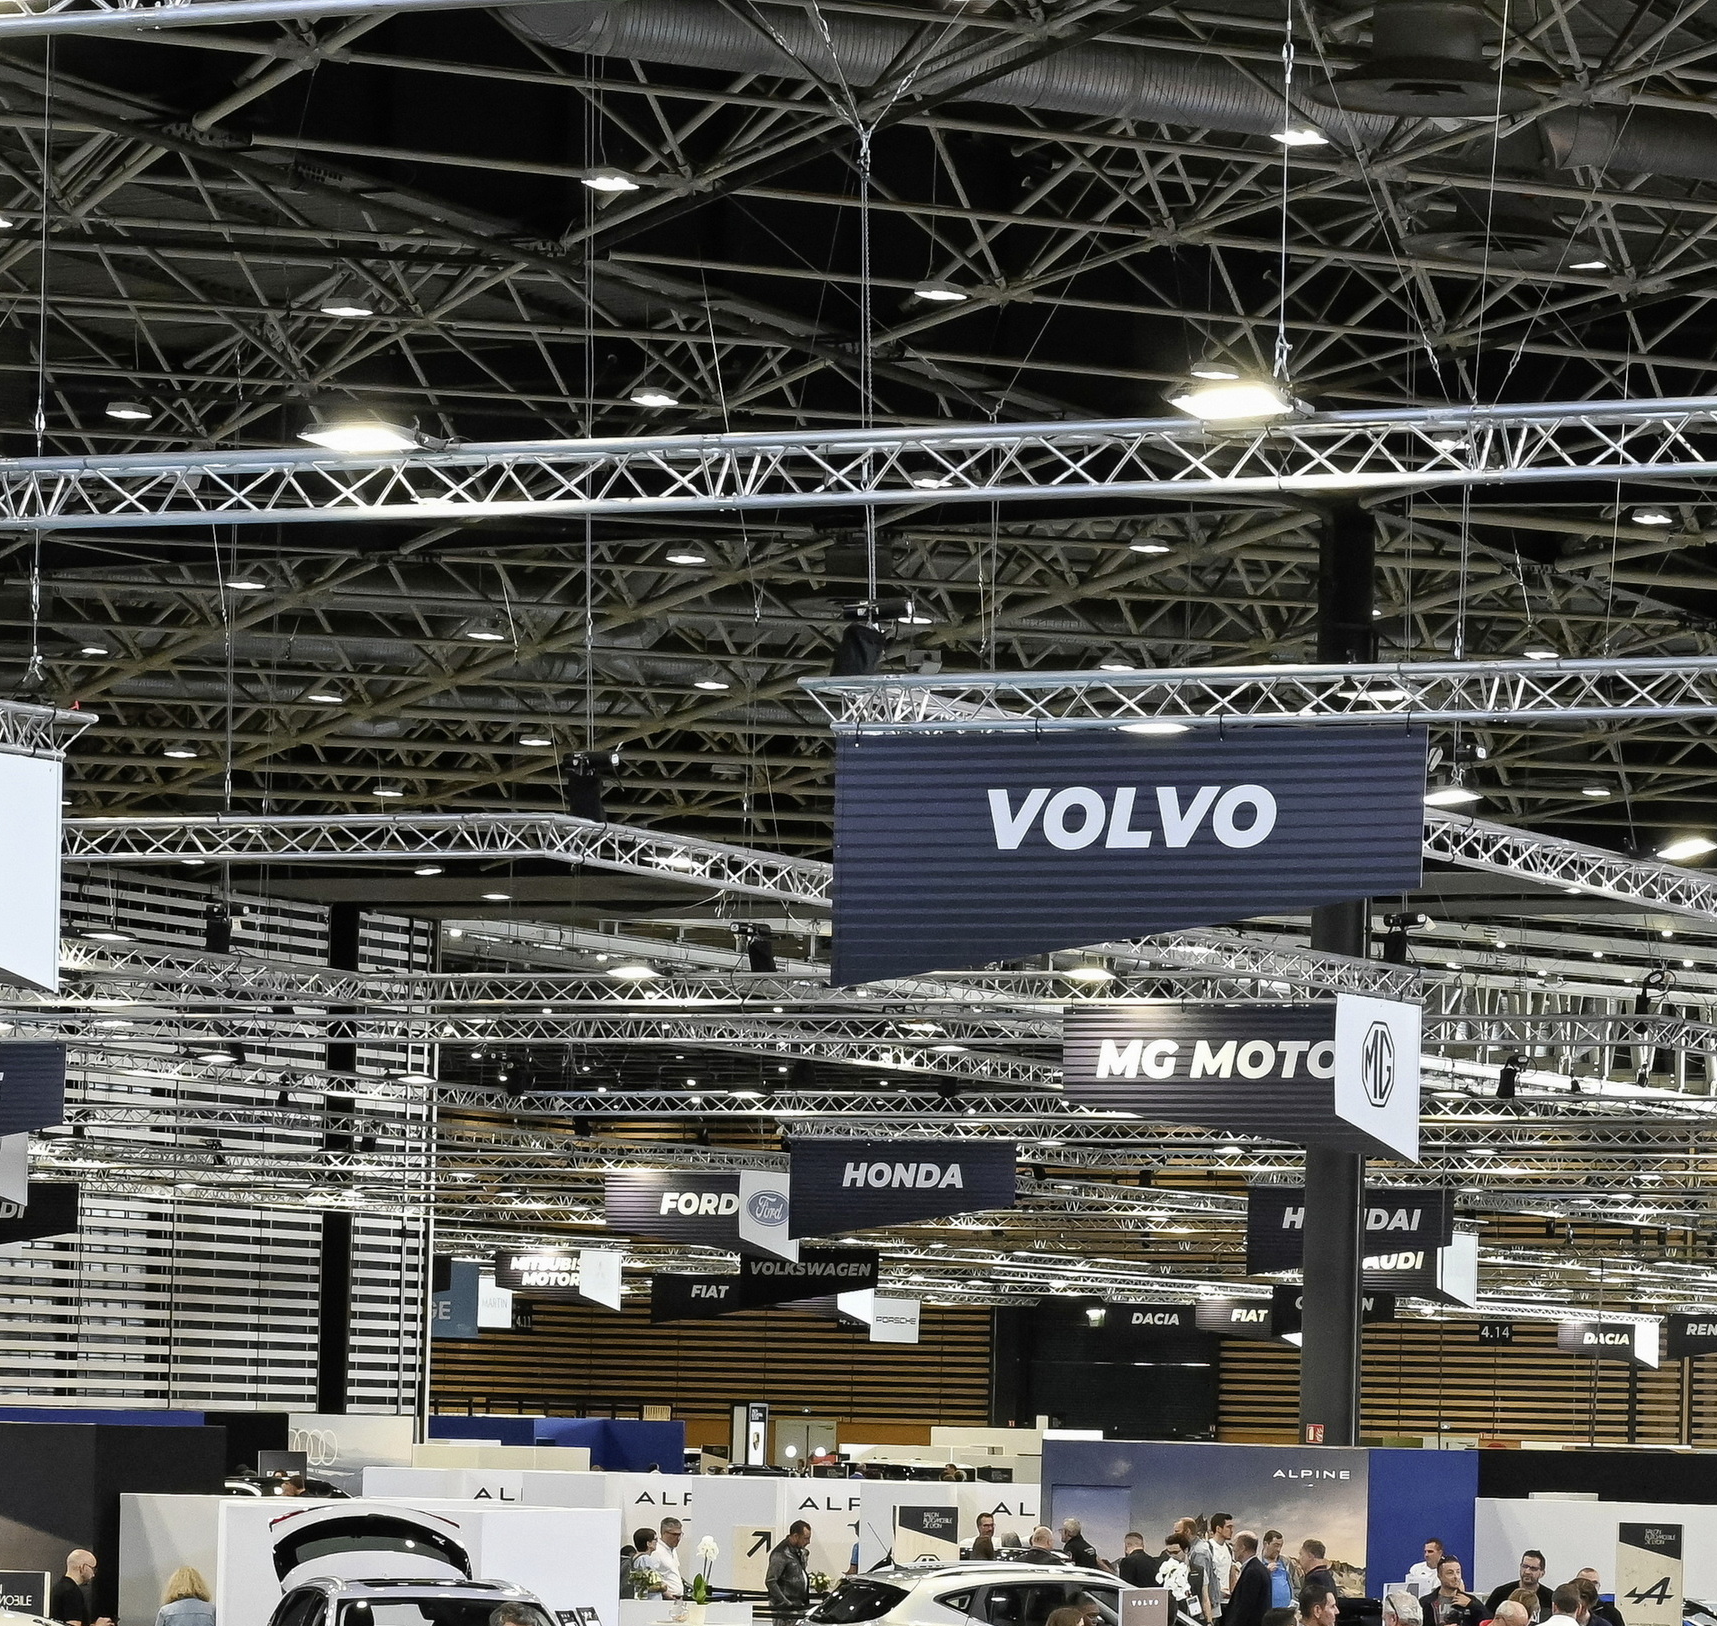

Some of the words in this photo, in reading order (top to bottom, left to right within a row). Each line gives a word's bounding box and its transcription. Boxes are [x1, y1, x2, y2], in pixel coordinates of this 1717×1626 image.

[987, 784, 1278, 850] VOLVO
[1095, 1040, 1179, 1080] MG
[1189, 1039, 1336, 1080] MOTO
[842, 1162, 963, 1190] HONDA
[659, 1192, 741, 1215] FORD
[755, 1196, 784, 1220] Ford
[1362, 1251, 1424, 1271] AUDI
[750, 1261, 872, 1277] VOLKSWAGEN
[522, 1271, 580, 1286] MOTOR
[690, 1284, 729, 1299] FIAT
[876, 1315, 917, 1325] PORSCHE
[1131, 1312, 1180, 1326] DACIA
[1231, 1308, 1269, 1323] FIAT
[1481, 1325, 1511, 1340] 4.14
[1582, 1332, 1631, 1346] DACIA
[1272, 1468, 1351, 1481] ALPINE
[1131, 1599, 1159, 1607] VOLVO
